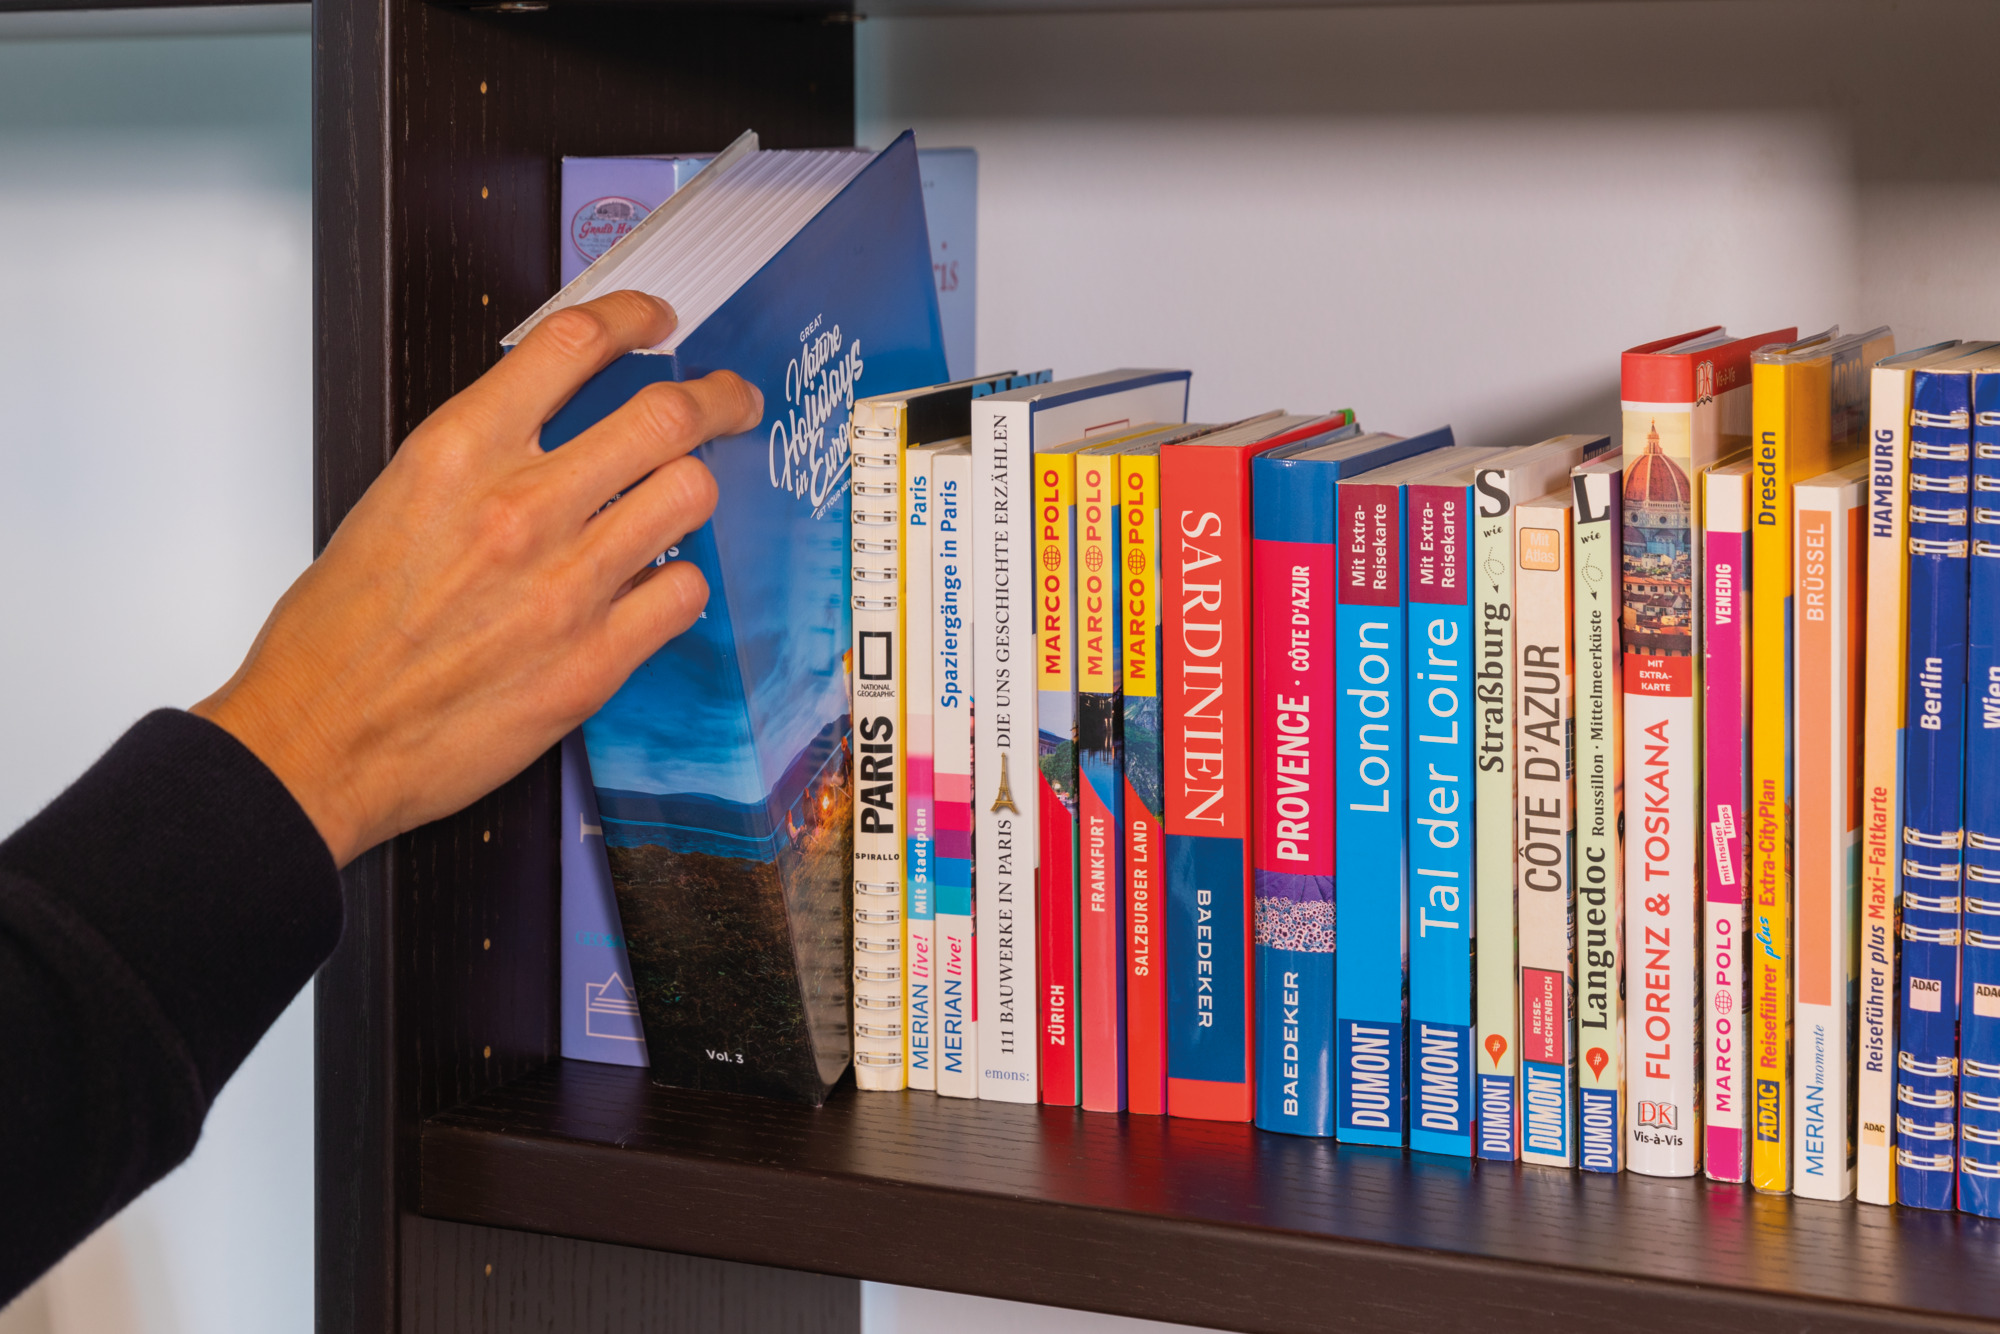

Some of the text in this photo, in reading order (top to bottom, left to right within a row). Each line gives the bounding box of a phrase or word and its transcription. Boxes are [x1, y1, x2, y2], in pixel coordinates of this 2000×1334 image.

[786, 324, 842, 405] Nature
[800, 313, 822, 342] GREAT
[769, 339, 863, 492] Holidays
[796, 469, 808, 500] in
[910, 475, 927, 526] Paris
[1476, 470, 1510, 518] S
[1574, 474, 1610, 524] L
[1758, 431, 1776, 526] Dresden
[1874, 430, 1894, 538] HAMBURG
[1043, 470, 1061, 674] MARCO POLO
[1086, 470, 1103, 675] MARCO POLO
[1352, 504, 1366, 587] Mit Extra-
[1372, 503, 1387, 590] Reisekarte
[1420, 502, 1434, 585] Mit Extra-
[1441, 501, 1455, 588] Reisekarte
[1483, 524, 1504, 538] wie
[1525, 548, 1555, 563] Atlas
[1530, 533, 1550, 546] Mit
[1581, 531, 1601, 544] wie
[1802, 523, 1824, 621] BRÜSSEL
[940, 480, 962, 708] Spaziergänge in Paris
[1128, 472, 1146, 679] MARCO POLO
[1715, 564, 1732, 625] VENEDIG
[857, 690, 895, 698] GEOGRAPHIC
[1180, 510, 1224, 826] SARDINIEN
[1477, 602, 1510, 773] Straßburg
[1639, 671, 1672, 680] EXTRA-
[1641, 682, 1671, 692] KARTE
[1648, 660, 1664, 668] MIT
[1920, 657, 1942, 730] Berlin
[1982, 666, 2000, 728] Wien
[991, 415, 1014, 1054] 111 BAUWERKE IN PARIS DIE UNS GESCHICHTE ERZÄHLEN
[1277, 566, 1310, 861] PROVENCE CÔTE D'AZUR
[1347, 622, 1390, 812] London
[860, 716, 894, 834] PARIS
[1417, 618, 1459, 937] Tal der Loire
[1519, 645, 1562, 892] CÔTE D'AZUR
[855, 852, 900, 860] SPIRALLO
[915, 808, 929, 914] Mit Stadtplan
[1580, 610, 1614, 1030] Languedoc Roussillon Mittelmeerküste
[1715, 826, 1731, 882] mit Insider
[1722, 807, 1732, 836] Tipps
[1090, 816, 1105, 912] FRANKFURT
[1134, 821, 1149, 976] SALZBURGER LAND
[1644, 719, 1670, 1079] FLORENZ & TOSKANA
[1197, 890, 1213, 1028] BAEDEKER
[1755, 779, 1782, 1069] Reiseführer plus Extra-CityPlan
[1866, 786, 1889, 1072] Reiseführer plus Maxi-Faltkarte
[912, 934, 929, 1070] MERIAN live!
[944, 936, 962, 1073] MERIAN live!
[1048, 985, 1065, 1045] ZÜRICH
[1533, 997, 1542, 1034] REISE-
[1544, 976, 1553, 1058] TASCHENBUCH
[1716, 919, 1731, 1112] MARCO POLO
[1912, 979, 1939, 991] ADAC
[706, 1049, 744, 1064] Vol. 3
[985, 1069, 1030, 1082] emons:
[1284, 971, 1298, 1116] BAEDEKER
[1352, 1024, 1390, 1128] DUMONT
[1421, 1025, 1459, 1131] DUMONT
[1482, 1078, 1510, 1152] DUMONT
[1528, 1067, 1562, 1151] DUMONT
[1584, 1092, 1612, 1167] DUMONT
[1634, 1130, 1683, 1146] Vis-à-Vis
[1641, 1102, 1672, 1125] DK
[1758, 1083, 1777, 1139] ADAC
[1864, 1122, 1885, 1133] ADAC
